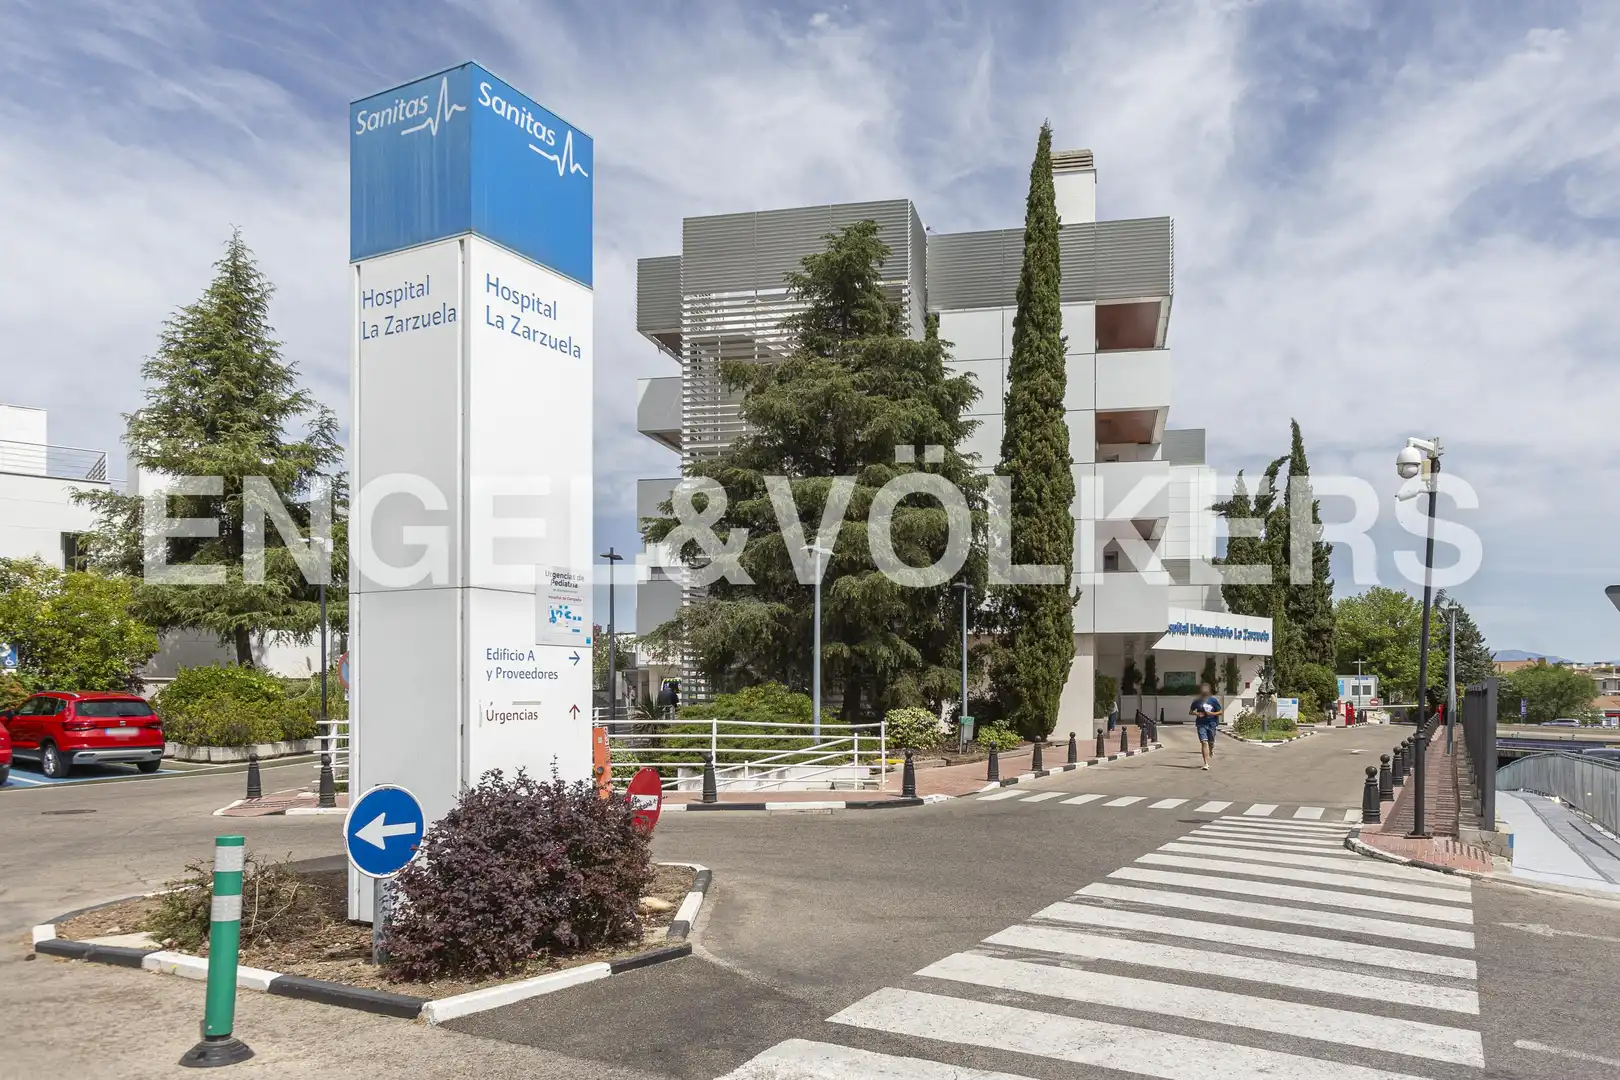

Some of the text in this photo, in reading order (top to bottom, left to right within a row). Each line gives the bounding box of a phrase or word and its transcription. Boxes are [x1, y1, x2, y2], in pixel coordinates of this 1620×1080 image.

[355, 95, 429, 135] Sanitas
[478, 81, 556, 147] Sanitas
[362, 274, 430, 310] Hospital
[486, 272, 557, 321] Hospital
[362, 302, 457, 341] La Zarzuela
[486, 304, 581, 360] La Zarzuela
[545, 570, 576, 581] Urgencias
[1168, 622, 1270, 643] spital Universitario La Zarzuela
[486, 648, 535, 662] Edificio A
[486, 666, 559, 682] y Proveedores
